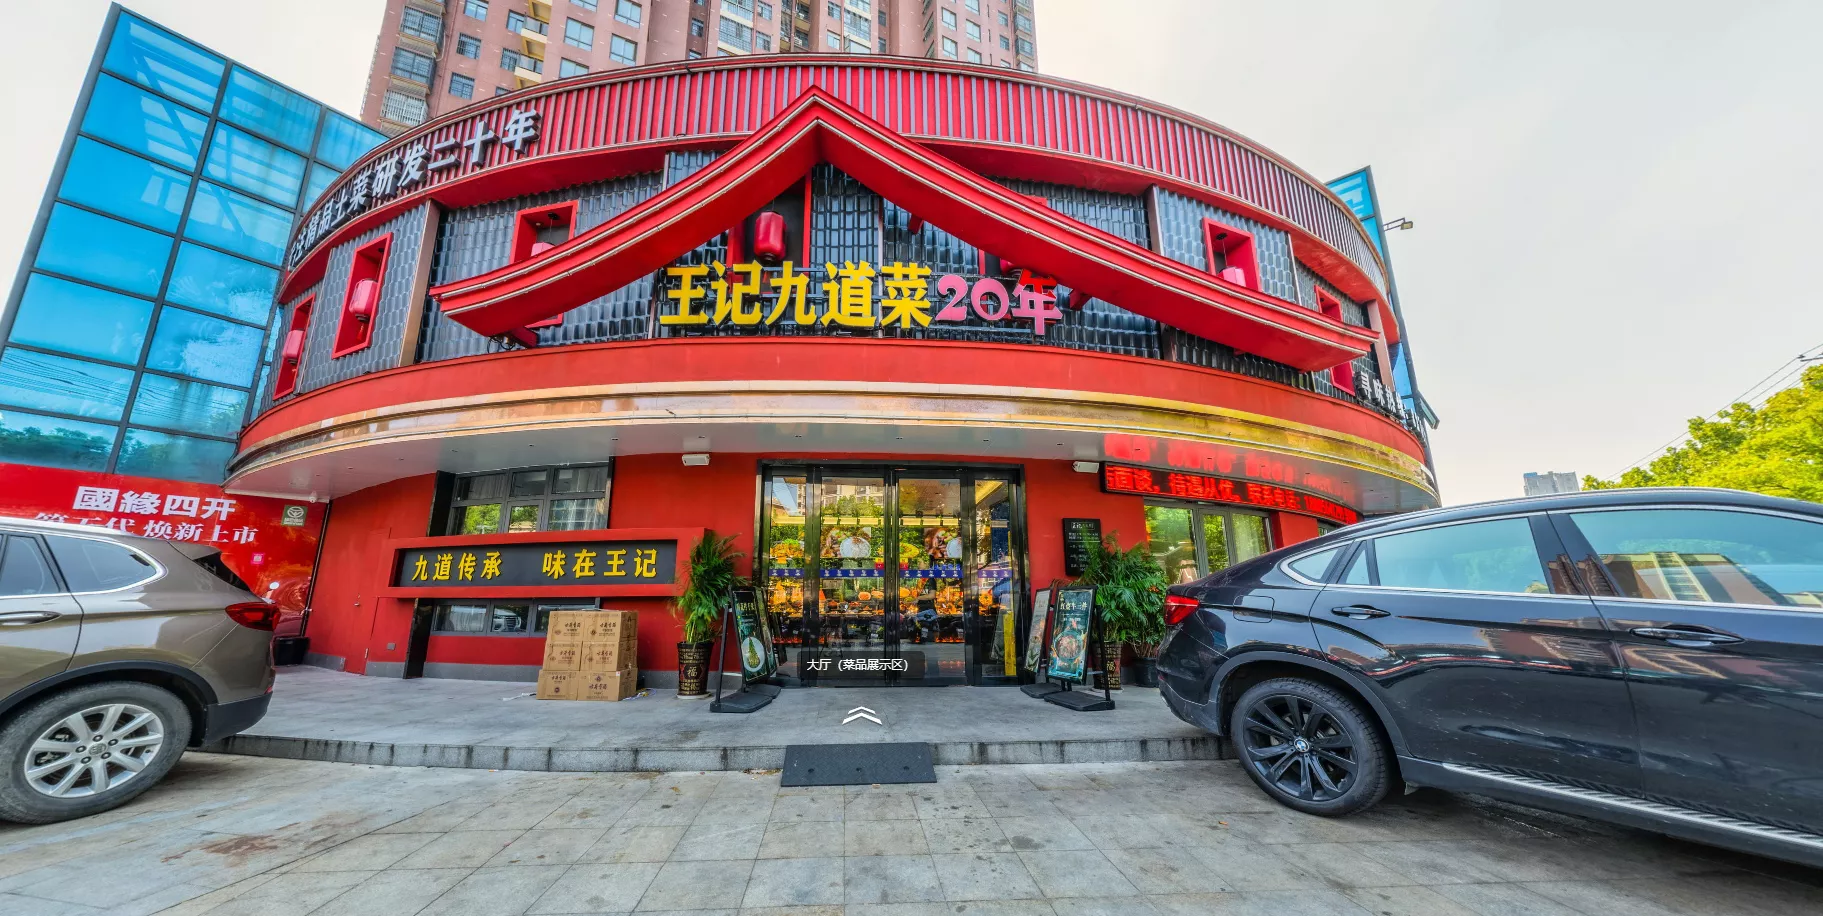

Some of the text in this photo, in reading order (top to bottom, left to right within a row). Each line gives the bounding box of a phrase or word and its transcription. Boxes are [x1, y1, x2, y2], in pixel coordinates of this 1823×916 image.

[659, 260, 1064, 336] 王记九道菜20年
[72, 485, 237, 521] 國緣四开
[411, 548, 658, 581] 九道传承 味在王记
